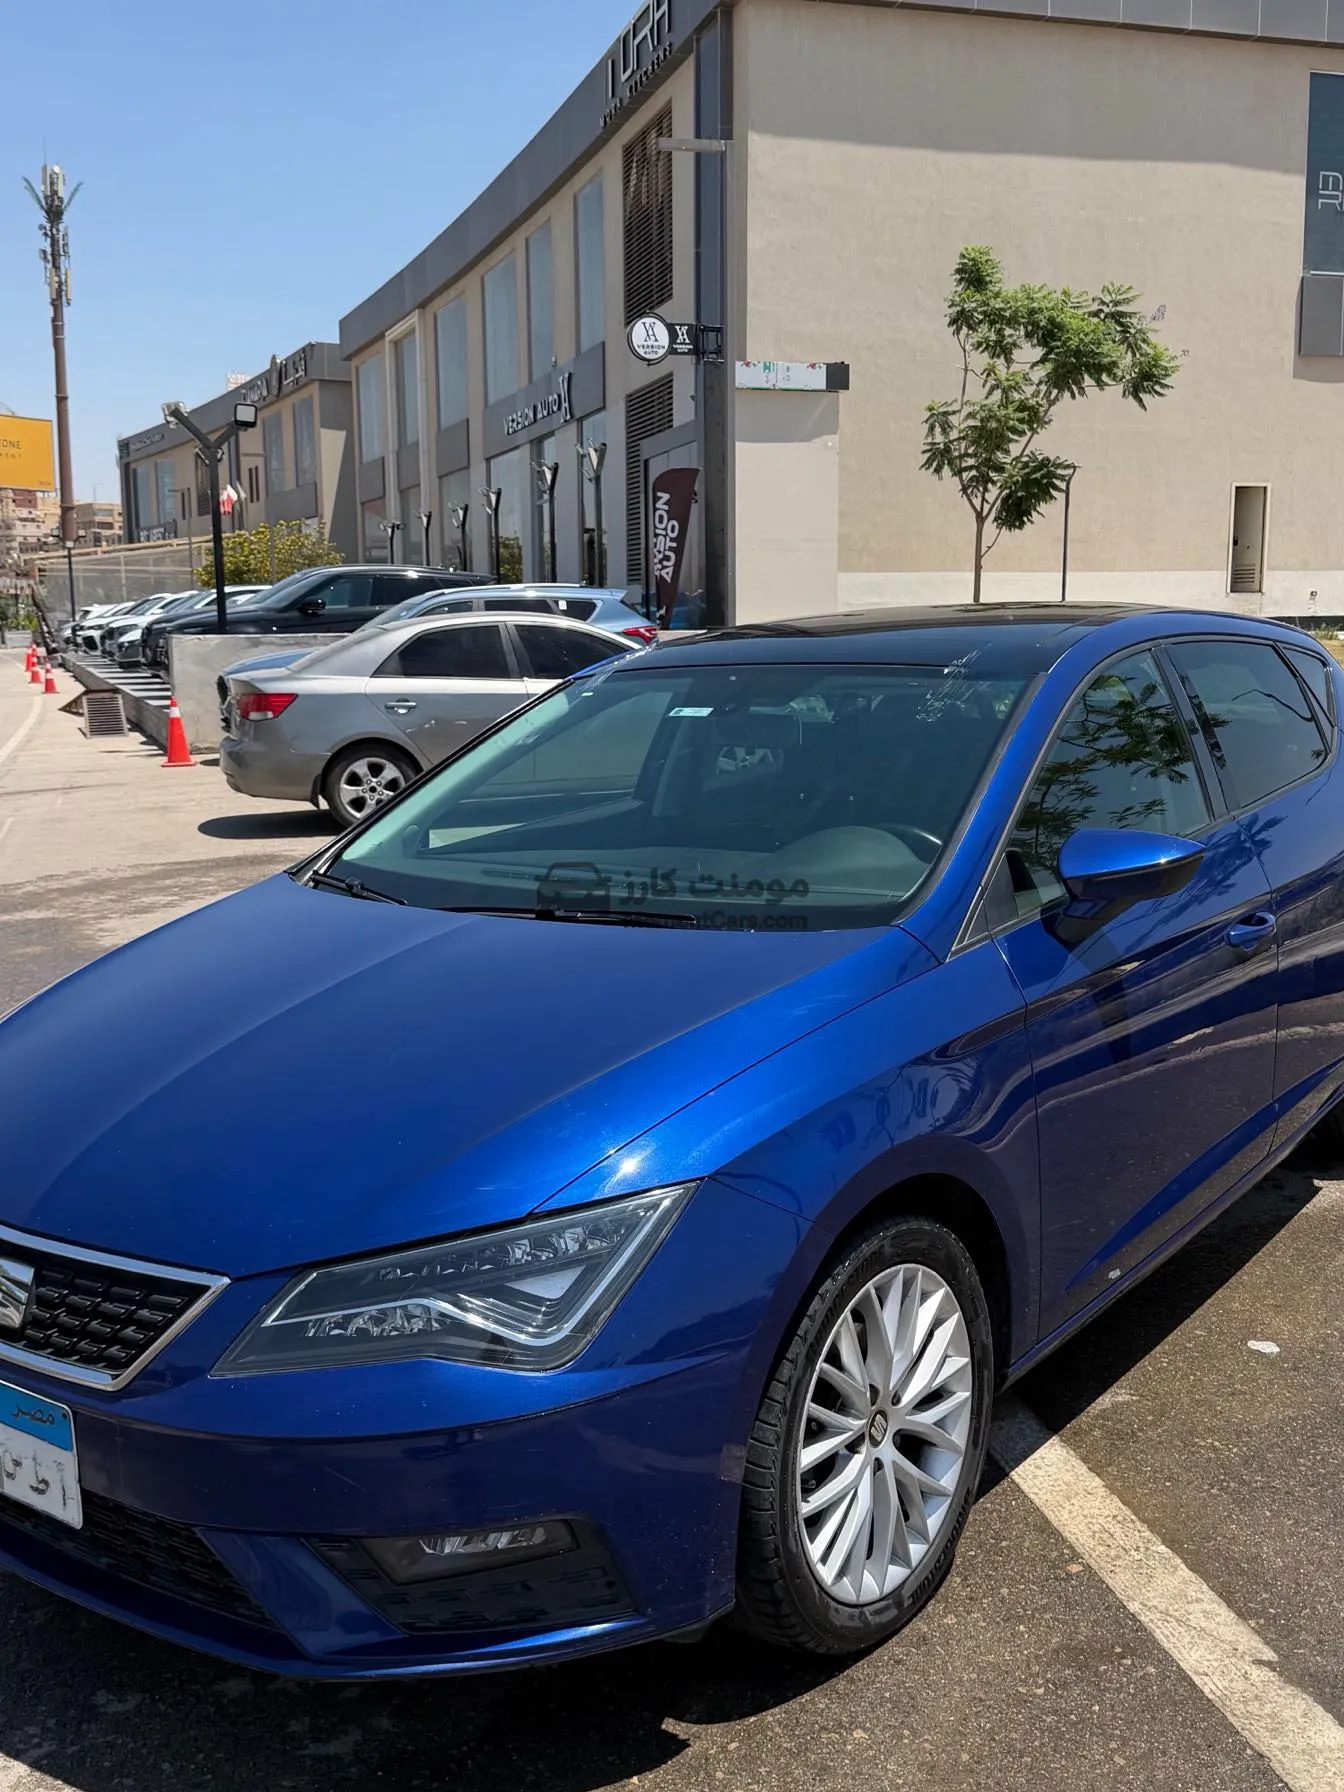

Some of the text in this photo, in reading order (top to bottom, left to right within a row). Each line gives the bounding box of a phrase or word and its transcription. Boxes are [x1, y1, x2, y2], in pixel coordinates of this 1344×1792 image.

[503, 404, 535, 435] VERSION
[537, 393, 559, 420] AUTO
[660, 519, 680, 584] AUTO
[10, 1404, 55, 1427] مصر
